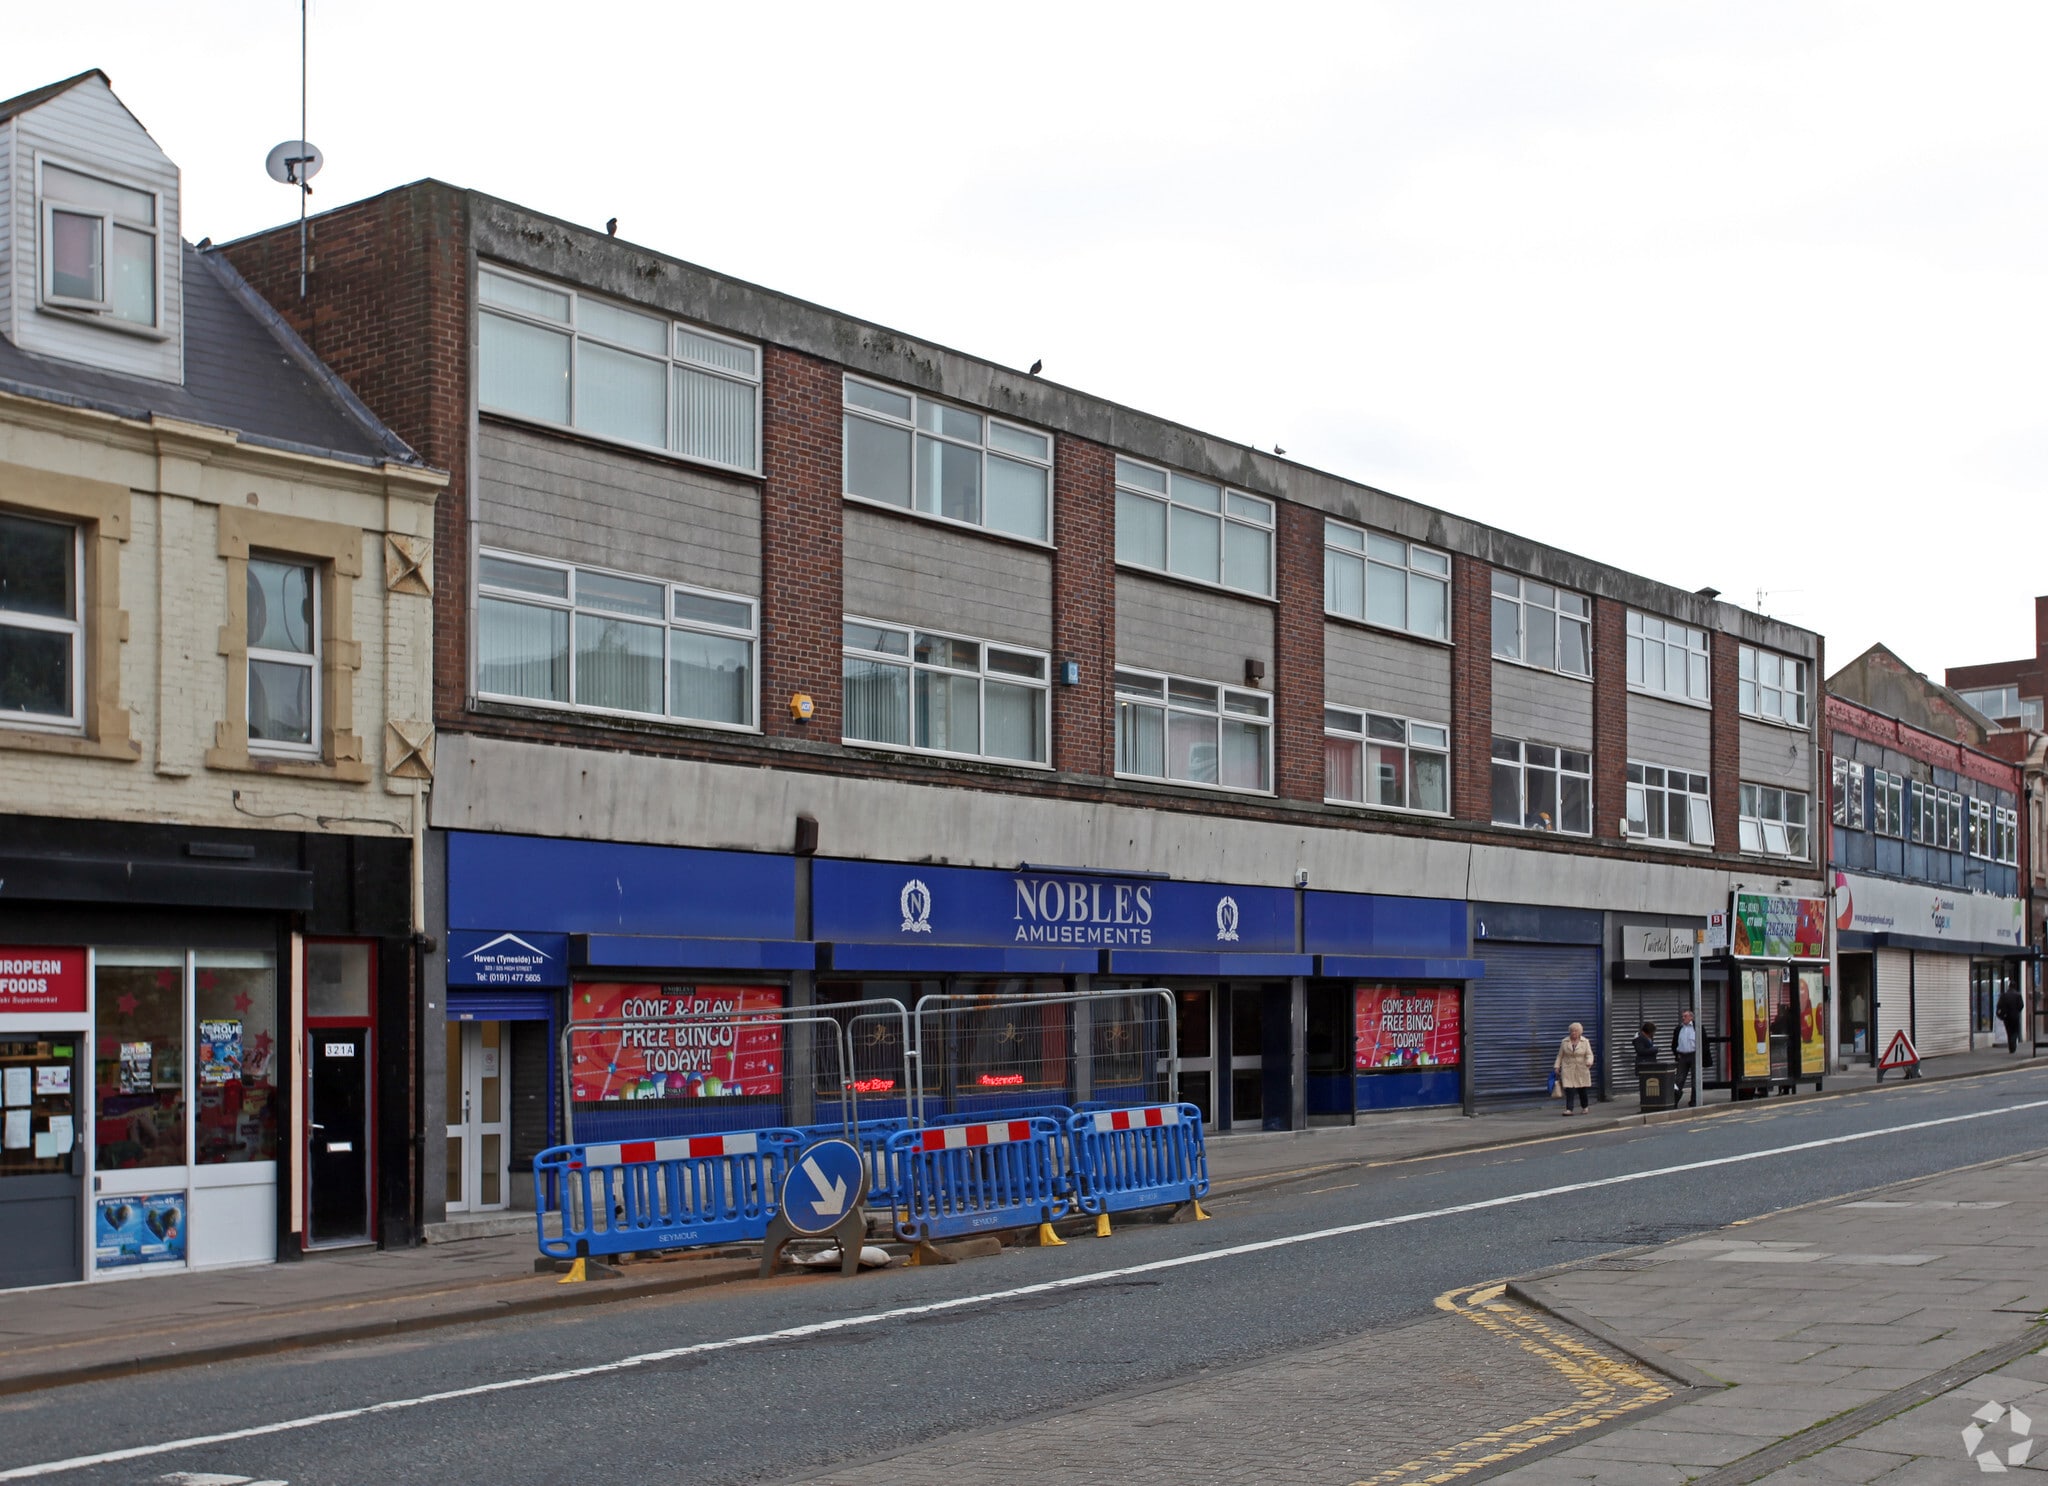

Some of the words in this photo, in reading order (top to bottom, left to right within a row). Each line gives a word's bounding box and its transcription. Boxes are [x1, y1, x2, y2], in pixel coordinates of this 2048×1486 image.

[911, 892, 922, 914] N
[1013, 879, 1152, 925] NOBLES
[1223, 907, 1233, 925] N
[1713, 915, 1721, 924] B
[1014, 924, 1152, 944] AMUSEMENTS
[1643, 932, 1668, 953] Twisted
[474, 954, 495, 963] Haven
[497, 954, 531, 965] (Tyneside)
[532, 956, 543, 964] Ltd
[476, 972, 487, 982] Tel:
[489, 973, 510, 983] (0191)
[511, 973, 523, 982] 477
[525, 974, 541, 983] 5605
[0, 978, 48, 993] FOODS
[12, 996, 58, 1004] Supermarket
[1381, 999, 1404, 1014] COME
[1406, 999, 1413, 1013] &
[1415, 999, 1434, 1013] PLAY
[621, 998, 670, 1020] COME
[674, 998, 690, 1020] &
[693, 999, 733, 1021] PLAY
[200, 1023, 242, 1034] TORQUE
[1382, 1014, 1404, 1031] FREE
[1406, 1014, 1434, 1031] BINGO
[210, 1033, 232, 1041] SHOW
[621, 1022, 670, 1048] FREE
[674, 1022, 734, 1047] BINGO
[1391, 1032, 1424, 1048] TODAY!!
[327, 1045, 353, 1055] 321A
[641, 1048, 712, 1073] TODAY!!
[871, 1077, 895, 1091] Bingo
[972, 1215, 999, 1227] SEYMOUR
[658, 1231, 698, 1242] SEYMOUR
